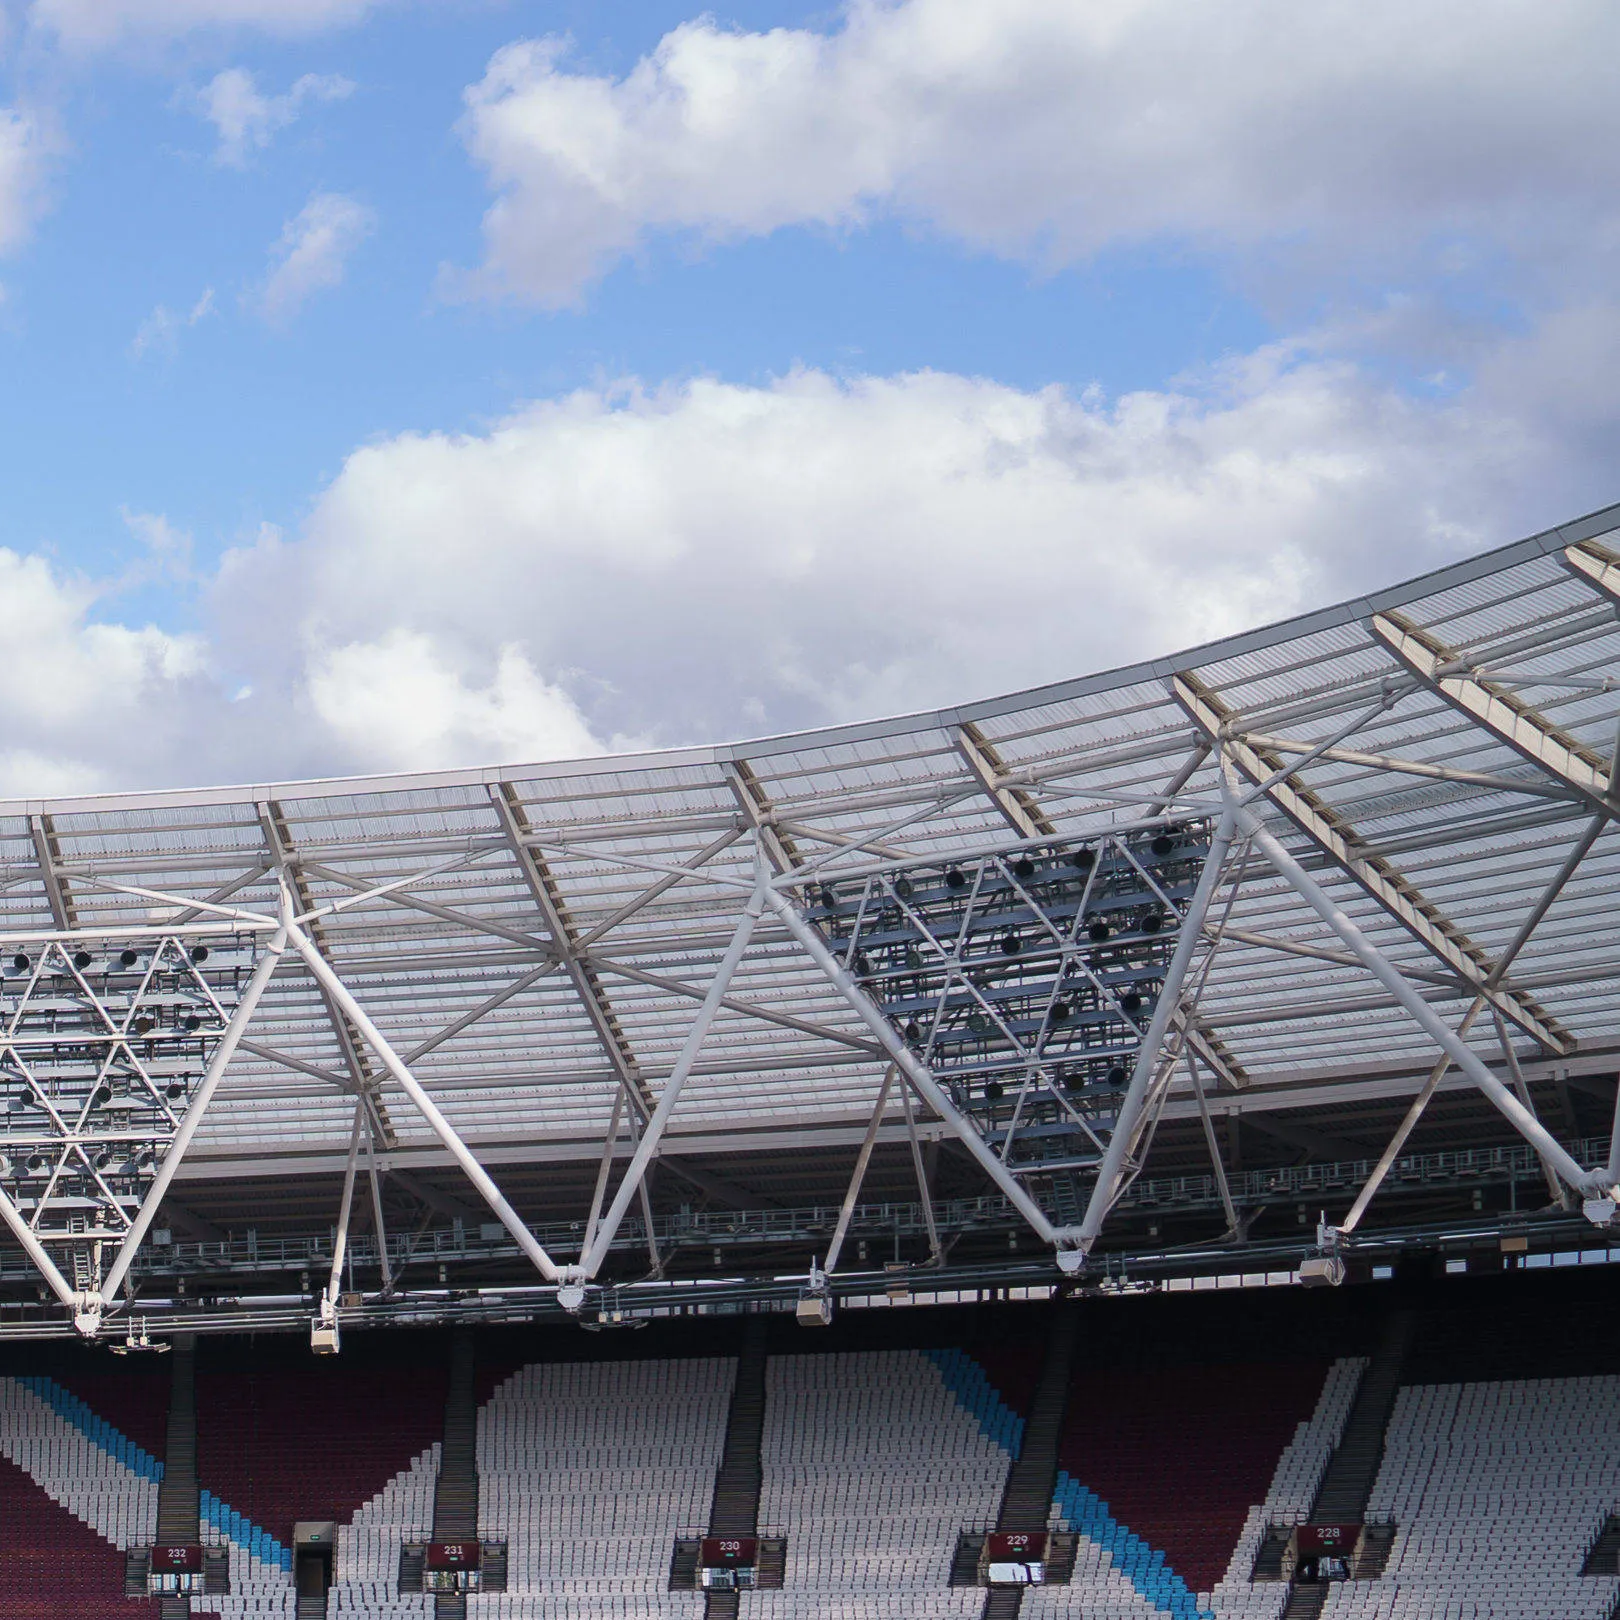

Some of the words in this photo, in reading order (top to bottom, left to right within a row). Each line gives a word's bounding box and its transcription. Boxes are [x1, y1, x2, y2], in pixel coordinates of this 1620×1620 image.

[1317, 1528, 1340, 1538] 228
[1007, 1535, 1028, 1545] 229
[444, 1545, 463, 1554] 231
[720, 1541, 739, 1551] 230
[168, 1548, 186, 1557] 232
